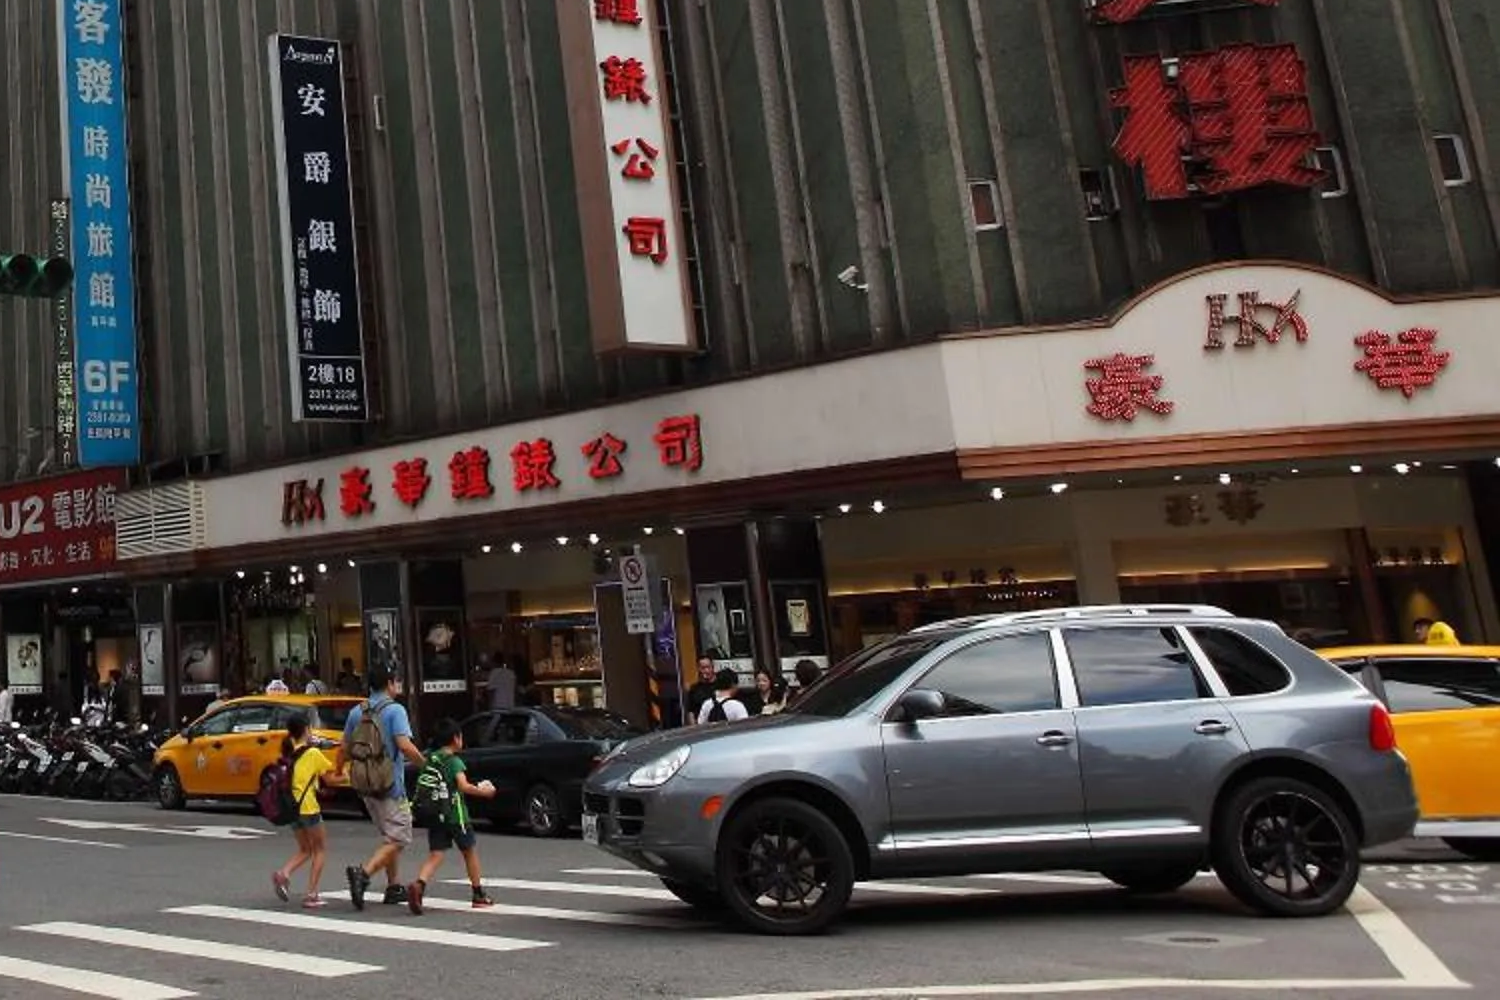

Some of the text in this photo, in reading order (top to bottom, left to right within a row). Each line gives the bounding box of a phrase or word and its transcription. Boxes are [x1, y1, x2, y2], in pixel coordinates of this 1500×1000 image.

[297, 83, 342, 324] 安爵銀飾
[83, 360, 130, 394] 6F
[52, 481, 117, 530] 電影館
[338, 413, 705, 520] 豪華鐘錶公司
